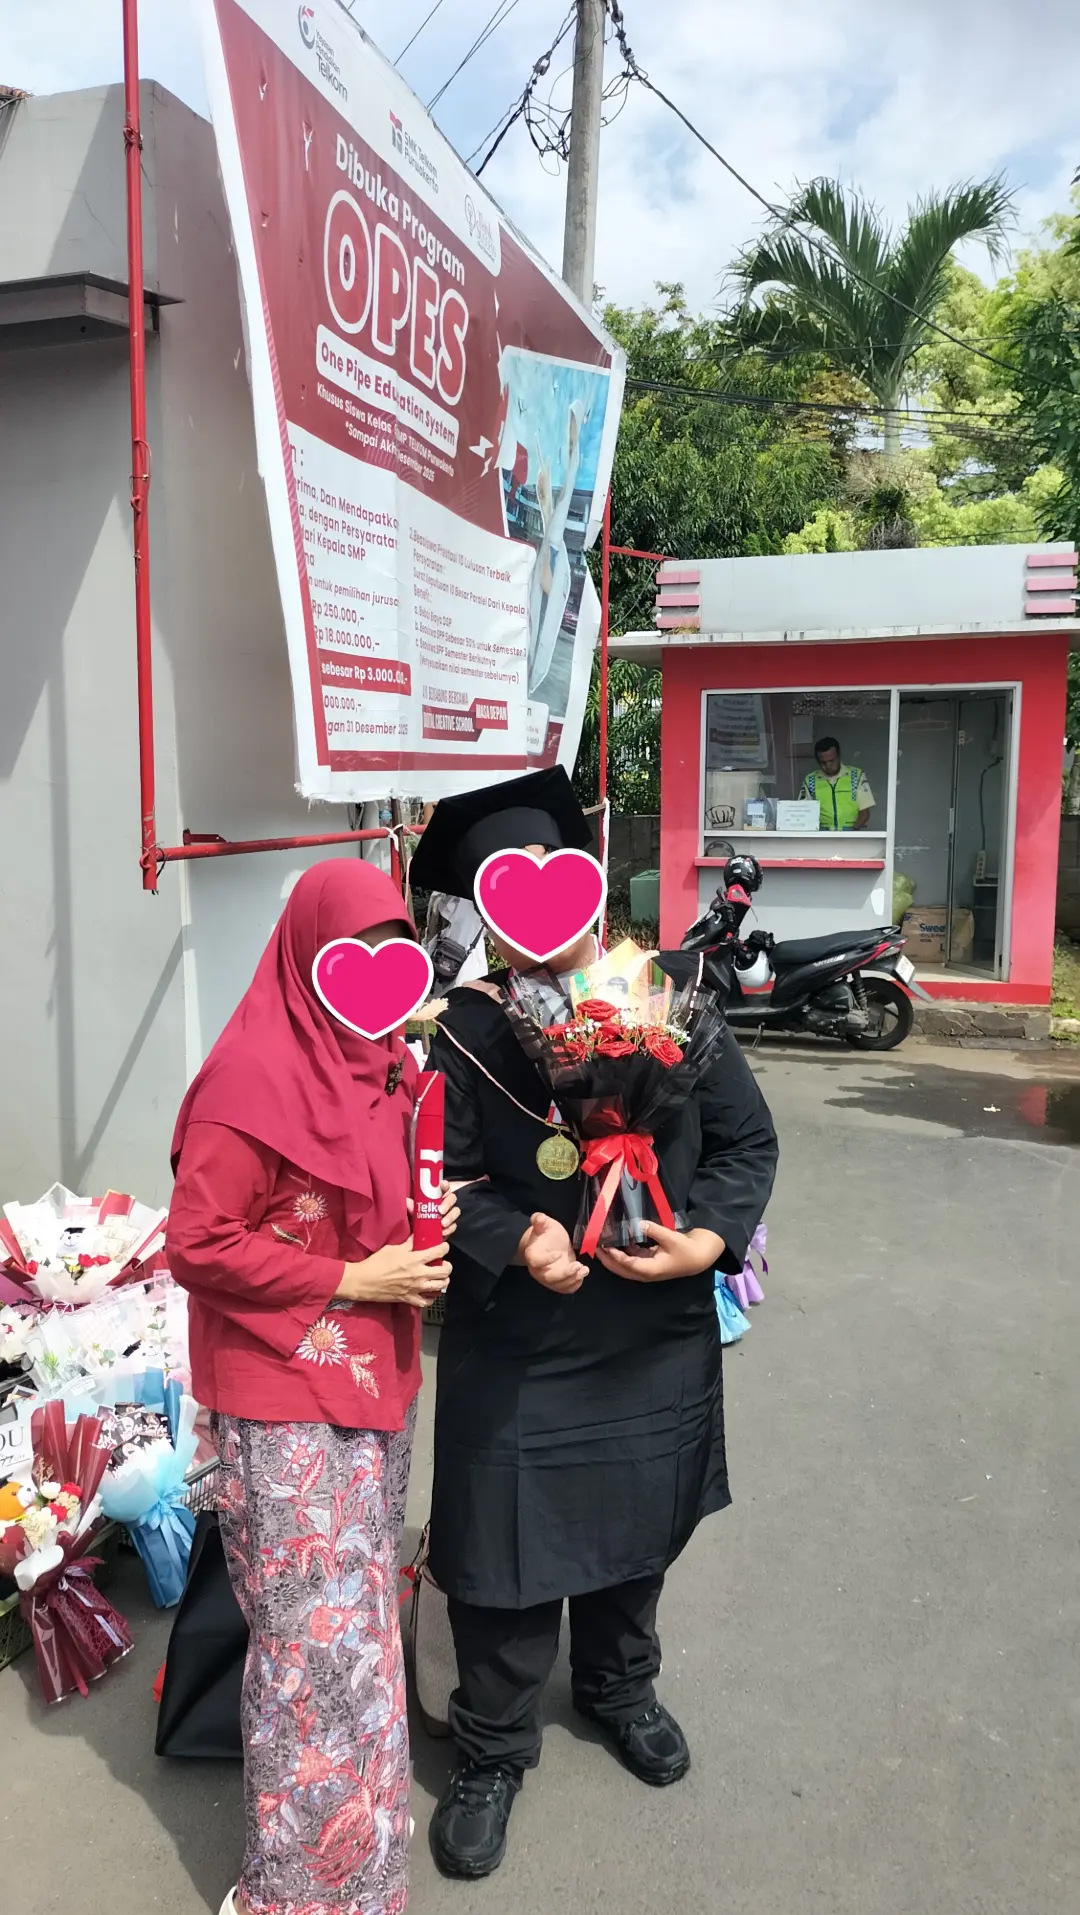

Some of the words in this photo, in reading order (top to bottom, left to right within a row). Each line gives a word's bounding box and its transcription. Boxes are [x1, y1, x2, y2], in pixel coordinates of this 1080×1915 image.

[316, 52, 347, 102] Telkom
[404, 131, 418, 153] SMK
[418, 147, 438, 179] Telkom
[404, 150, 438, 194] Purwokerto
[336, 133, 399, 222] Dibuka
[402, 200, 465, 286] Program
[323, 189, 469, 406] OPES
[321, 342, 343, 373] One
[346, 358, 371, 391] Pipe
[374, 375, 424, 424] Eduation
[425, 410, 455, 446] System
[317, 381, 343, 411] Khusus
[345, 399, 365, 422] Siswa
[367, 411, 392, 434] Kelas
[320, 488, 337, 509] Dan
[308, 506, 340, 532] dengan
[317, 531, 346, 556] Kepala
[347, 543, 366, 561] SMP
[464, 557, 486, 575] Lulusan
[486, 566, 511, 583] Terbaik
[314, 577, 332, 592] untuk
[334, 584, 370, 602] pemilihan
[312, 599, 322, 619] Rp
[324, 602, 365, 627] 250.000,-
[470, 591, 487, 607] Paralel
[487, 598, 500, 610] Dari
[501, 601, 525, 615] Kepala
[325, 627, 380, 652] 18.000.000,-
[476, 641, 491, 652] untuk
[492, 643, 523, 657] Semester
[321, 661, 353, 678] sebesar
[354, 665, 366, 684] Rp
[346, 720, 354, 732] 31
[355, 720, 397, 735] Desember
[919, 922, 949, 933] Swee
